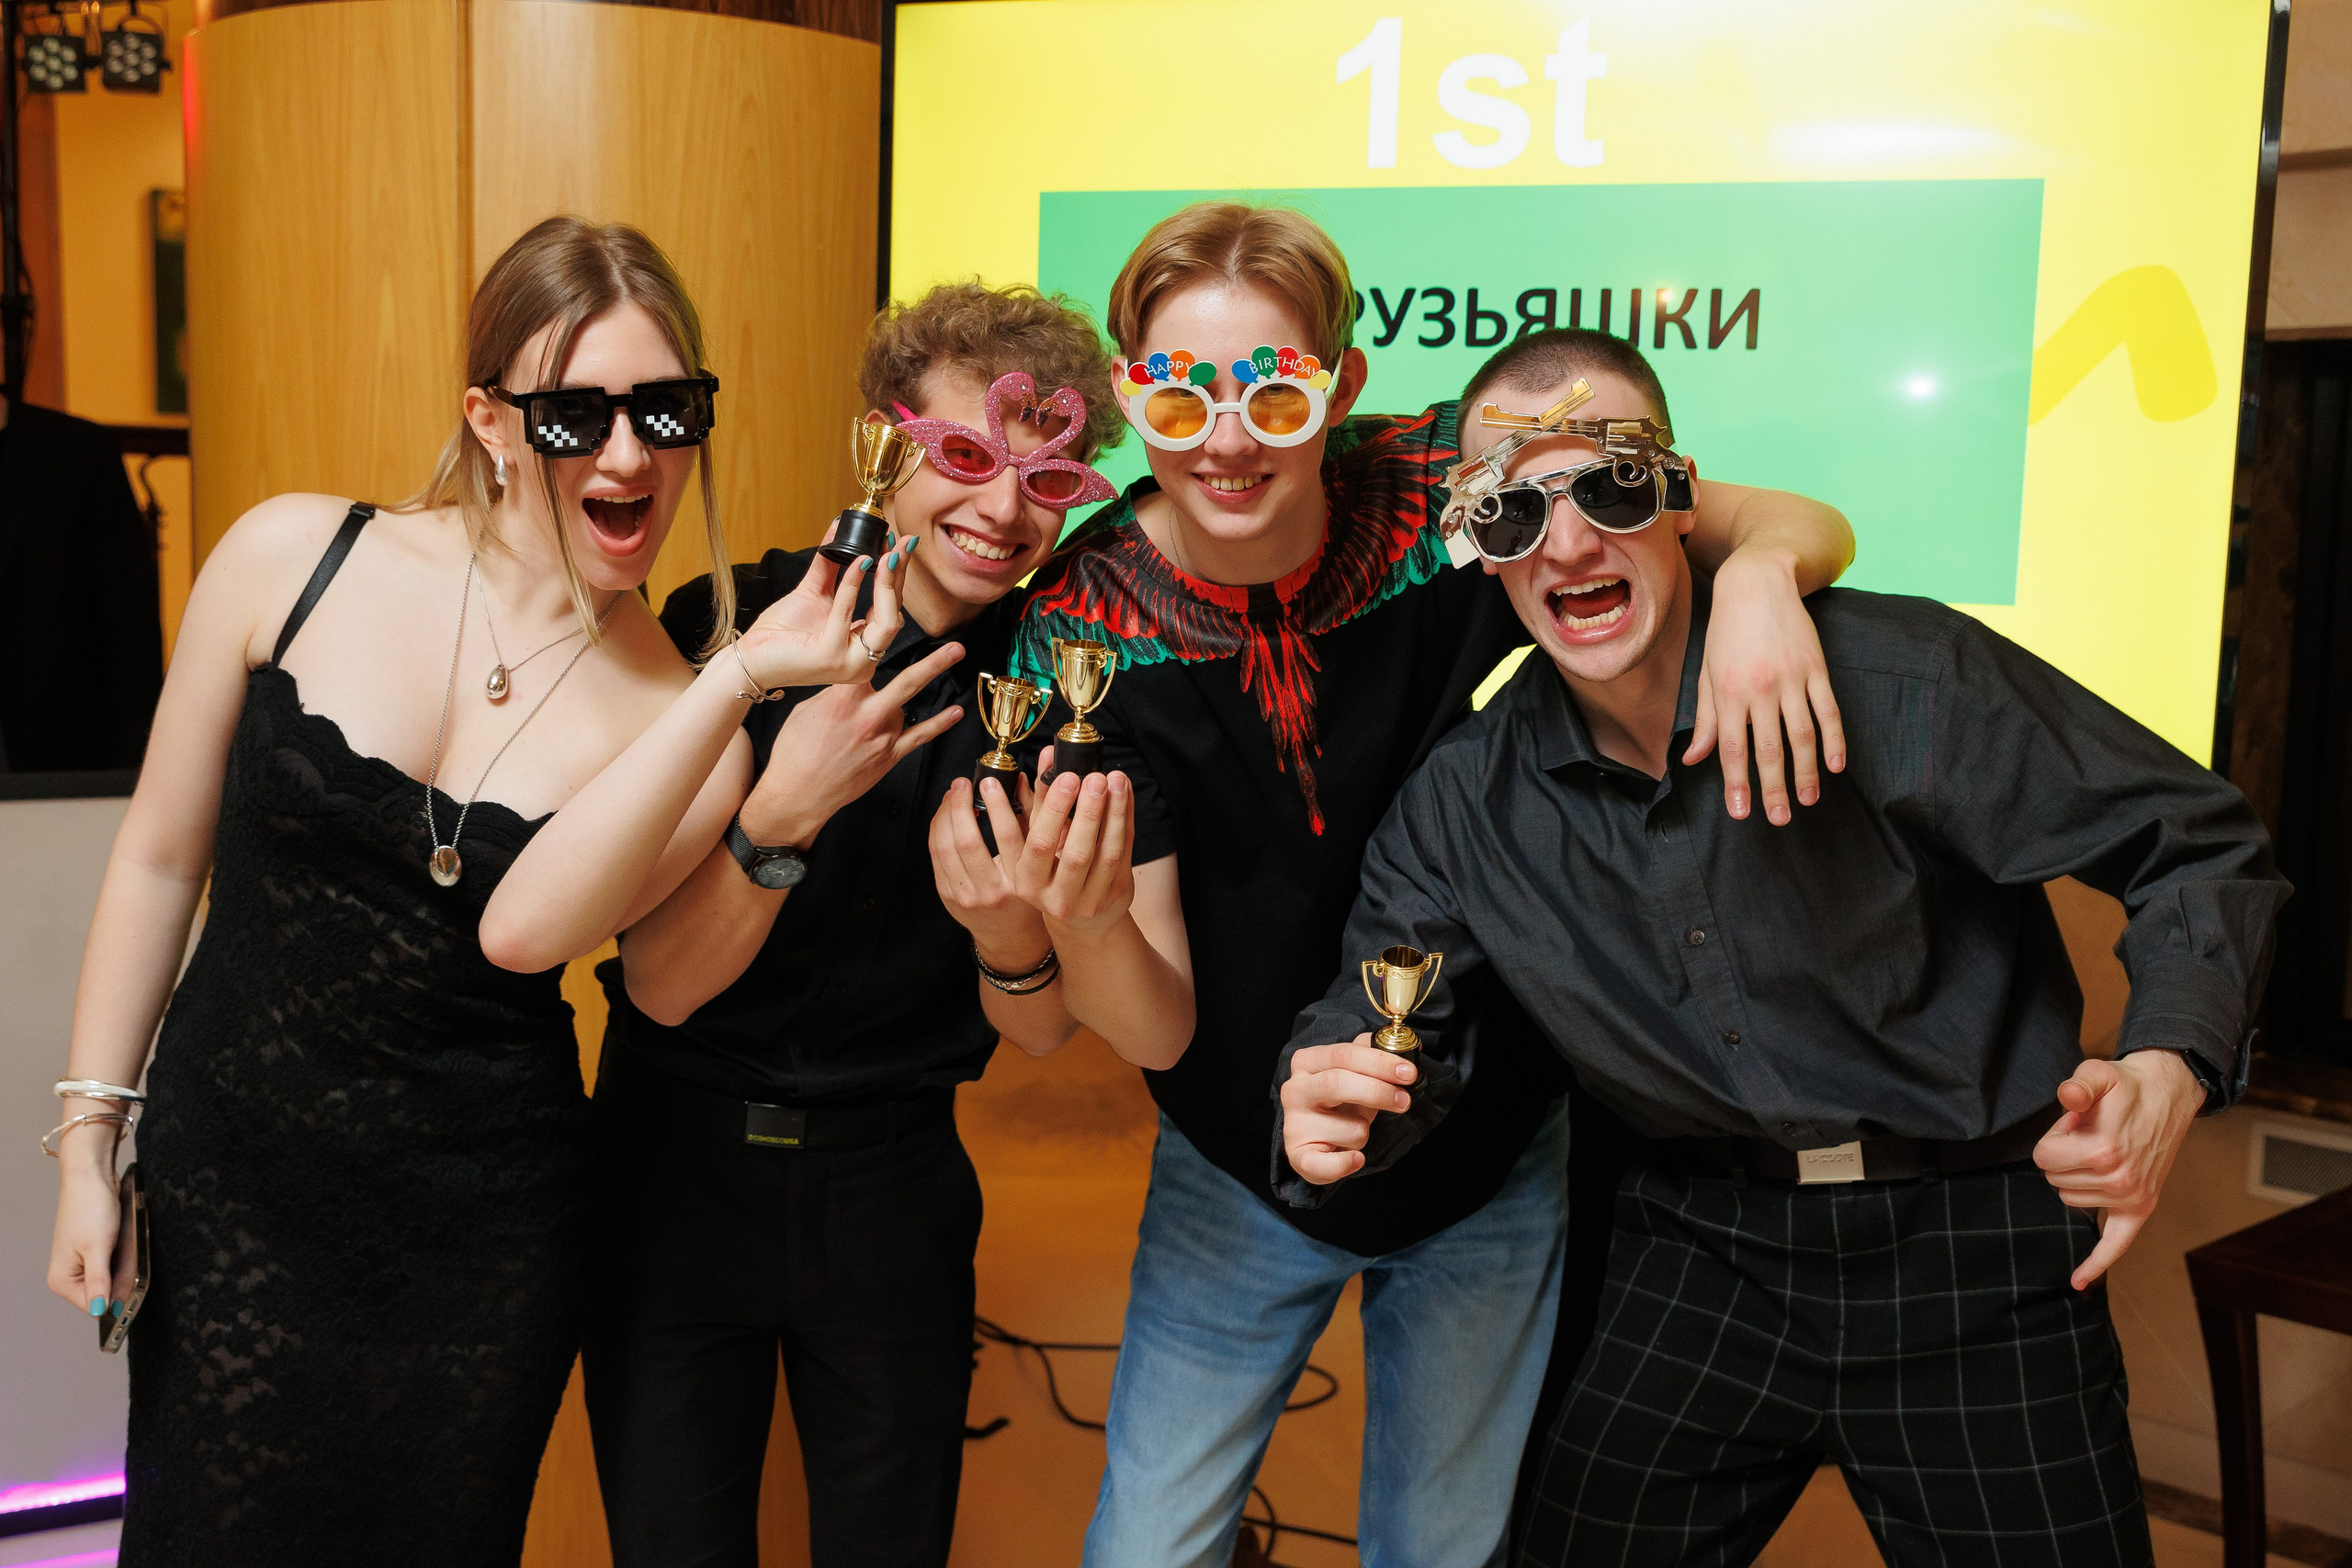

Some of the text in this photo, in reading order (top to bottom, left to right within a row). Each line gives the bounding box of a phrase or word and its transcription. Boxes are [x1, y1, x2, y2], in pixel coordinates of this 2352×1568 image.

[1336, 17, 1608, 169] 1st
[1144, 355, 1317, 378] HAPPY BIRTHDAY
